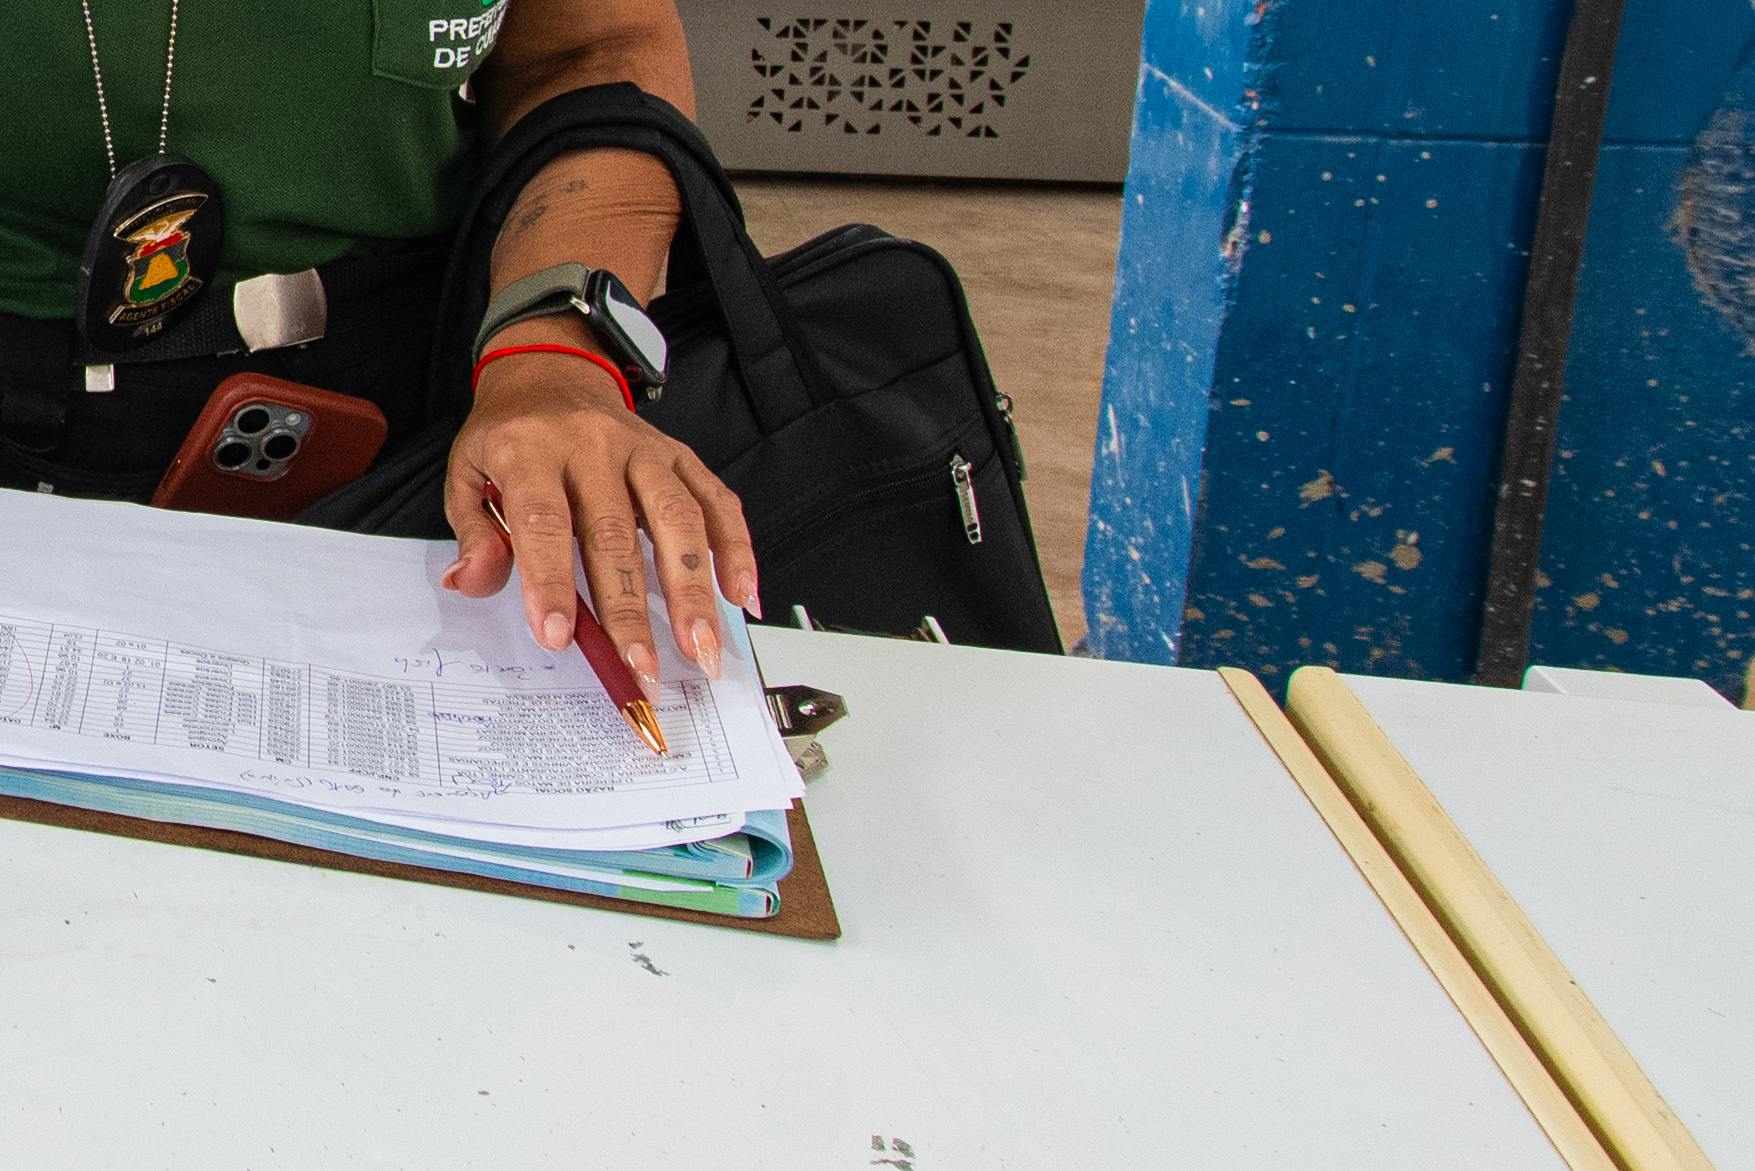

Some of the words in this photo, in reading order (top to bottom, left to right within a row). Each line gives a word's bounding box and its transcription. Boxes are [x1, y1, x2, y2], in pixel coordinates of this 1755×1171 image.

[434, 46, 471, 69] DE
[161, 284, 195, 313] FISCAL
[144, 322, 163, 337] 144
